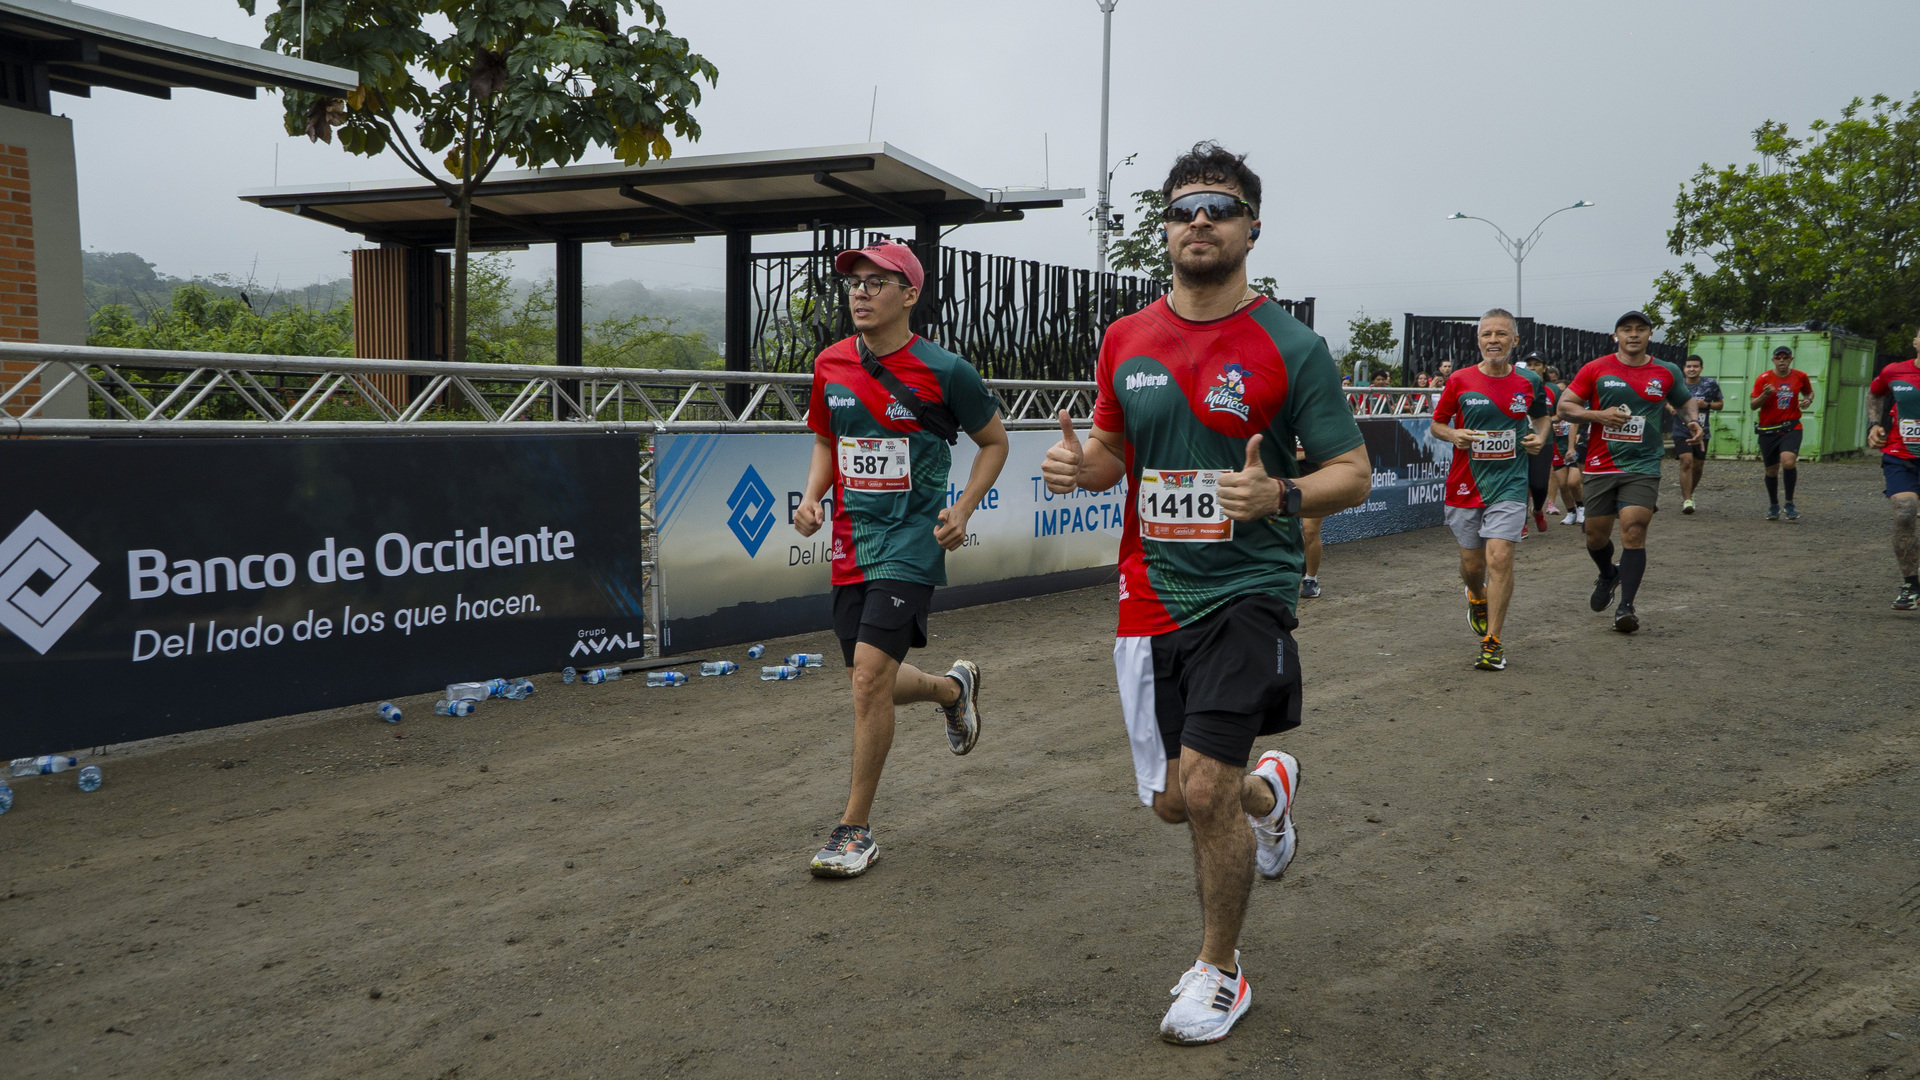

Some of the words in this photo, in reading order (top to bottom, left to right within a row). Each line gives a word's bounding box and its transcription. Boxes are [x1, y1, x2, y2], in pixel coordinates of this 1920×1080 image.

[1204, 391, 1250, 415] Muñeca
[1479, 440, 1510, 451] 1200
[853, 455, 889, 475] 587
[1407, 463, 1419, 481] TU
[1147, 493, 1215, 518] 1418
[128, 549, 296, 600] Banco
[307, 537, 366, 584] de
[375, 526, 575, 577] Occidente
[789, 542, 816, 566] Del
[132, 622, 196, 662] Del
[206, 615, 285, 653] lado
[292, 609, 333, 642] de
[342, 605, 385, 636] los
[394, 604, 447, 636] que
[455, 593, 541, 622] hacen.
[578, 627, 607, 638] Grupo
[569, 632, 641, 658] AVAL
